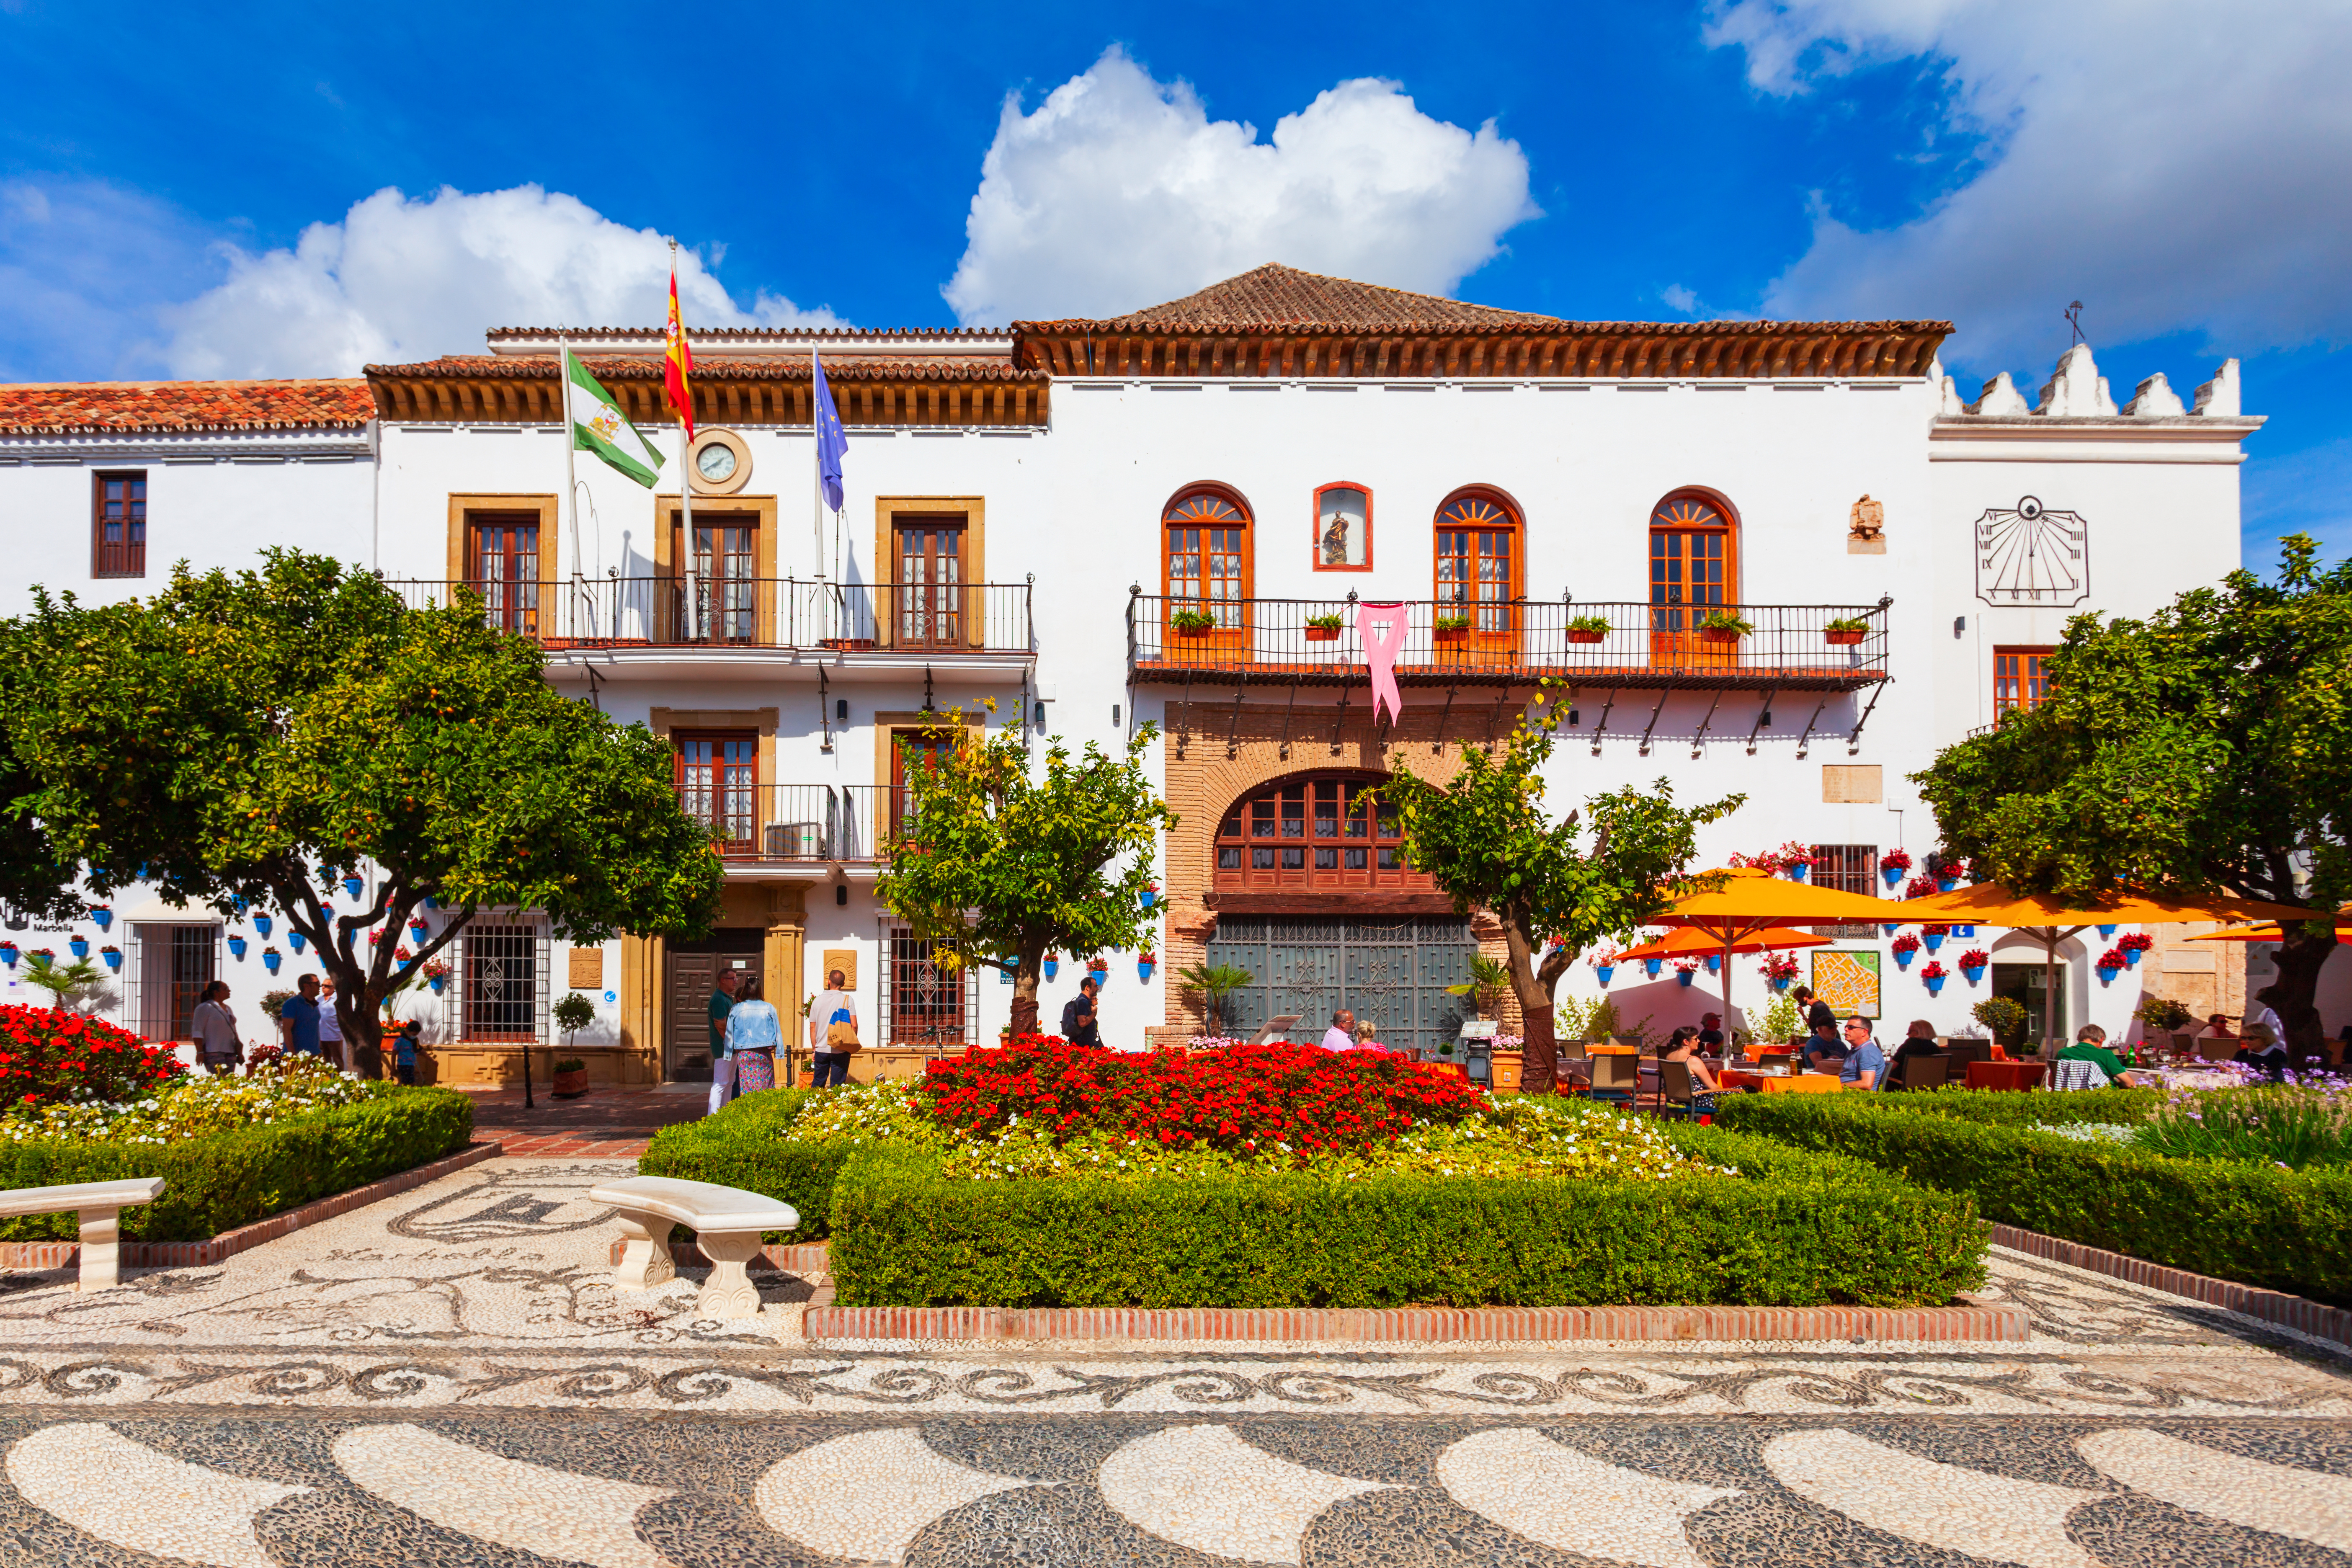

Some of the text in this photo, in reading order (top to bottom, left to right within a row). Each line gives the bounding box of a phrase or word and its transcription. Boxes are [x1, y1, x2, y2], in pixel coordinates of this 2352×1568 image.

[2069, 515, 2076, 524] V
[1978, 525, 1992, 535] VII
[2071, 531, 2083, 541] IIII
[1978, 541, 1991, 549] VIII
[2071, 549, 2080, 559] III
[1982, 559, 1993, 569] IX
[2072, 579, 2079, 589] II
[1990, 589, 1996, 599] X
[2011, 589, 2019, 599] XI
[2028, 589, 2040, 600] XII
[34, 923, 73, 932] Marbella
